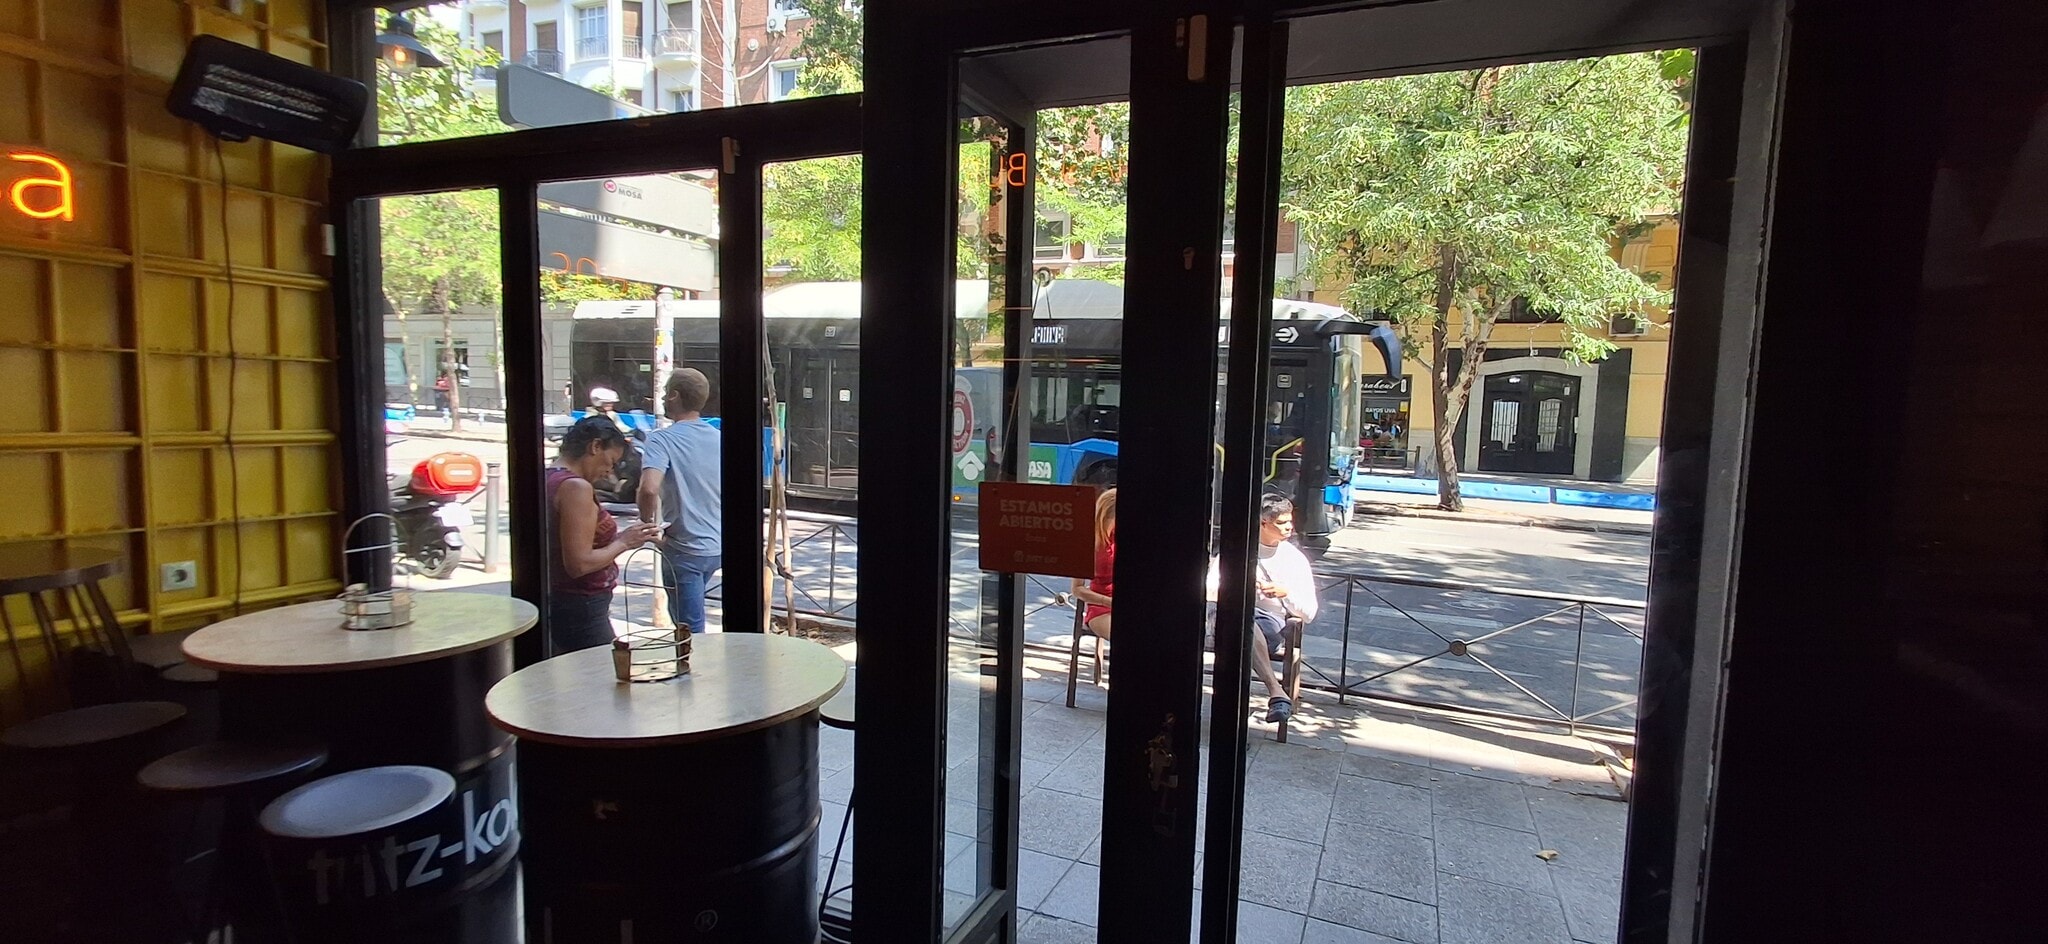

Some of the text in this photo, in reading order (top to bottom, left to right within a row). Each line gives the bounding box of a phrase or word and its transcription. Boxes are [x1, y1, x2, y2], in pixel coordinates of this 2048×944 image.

[0, 152, 73, 221] a
[618, 187, 643, 200] MOSA
[1000, 499, 1073, 515] ESTAMOS
[1000, 514, 1074, 531] ABIERTOS
[306, 762, 518, 904] fritz-kol
